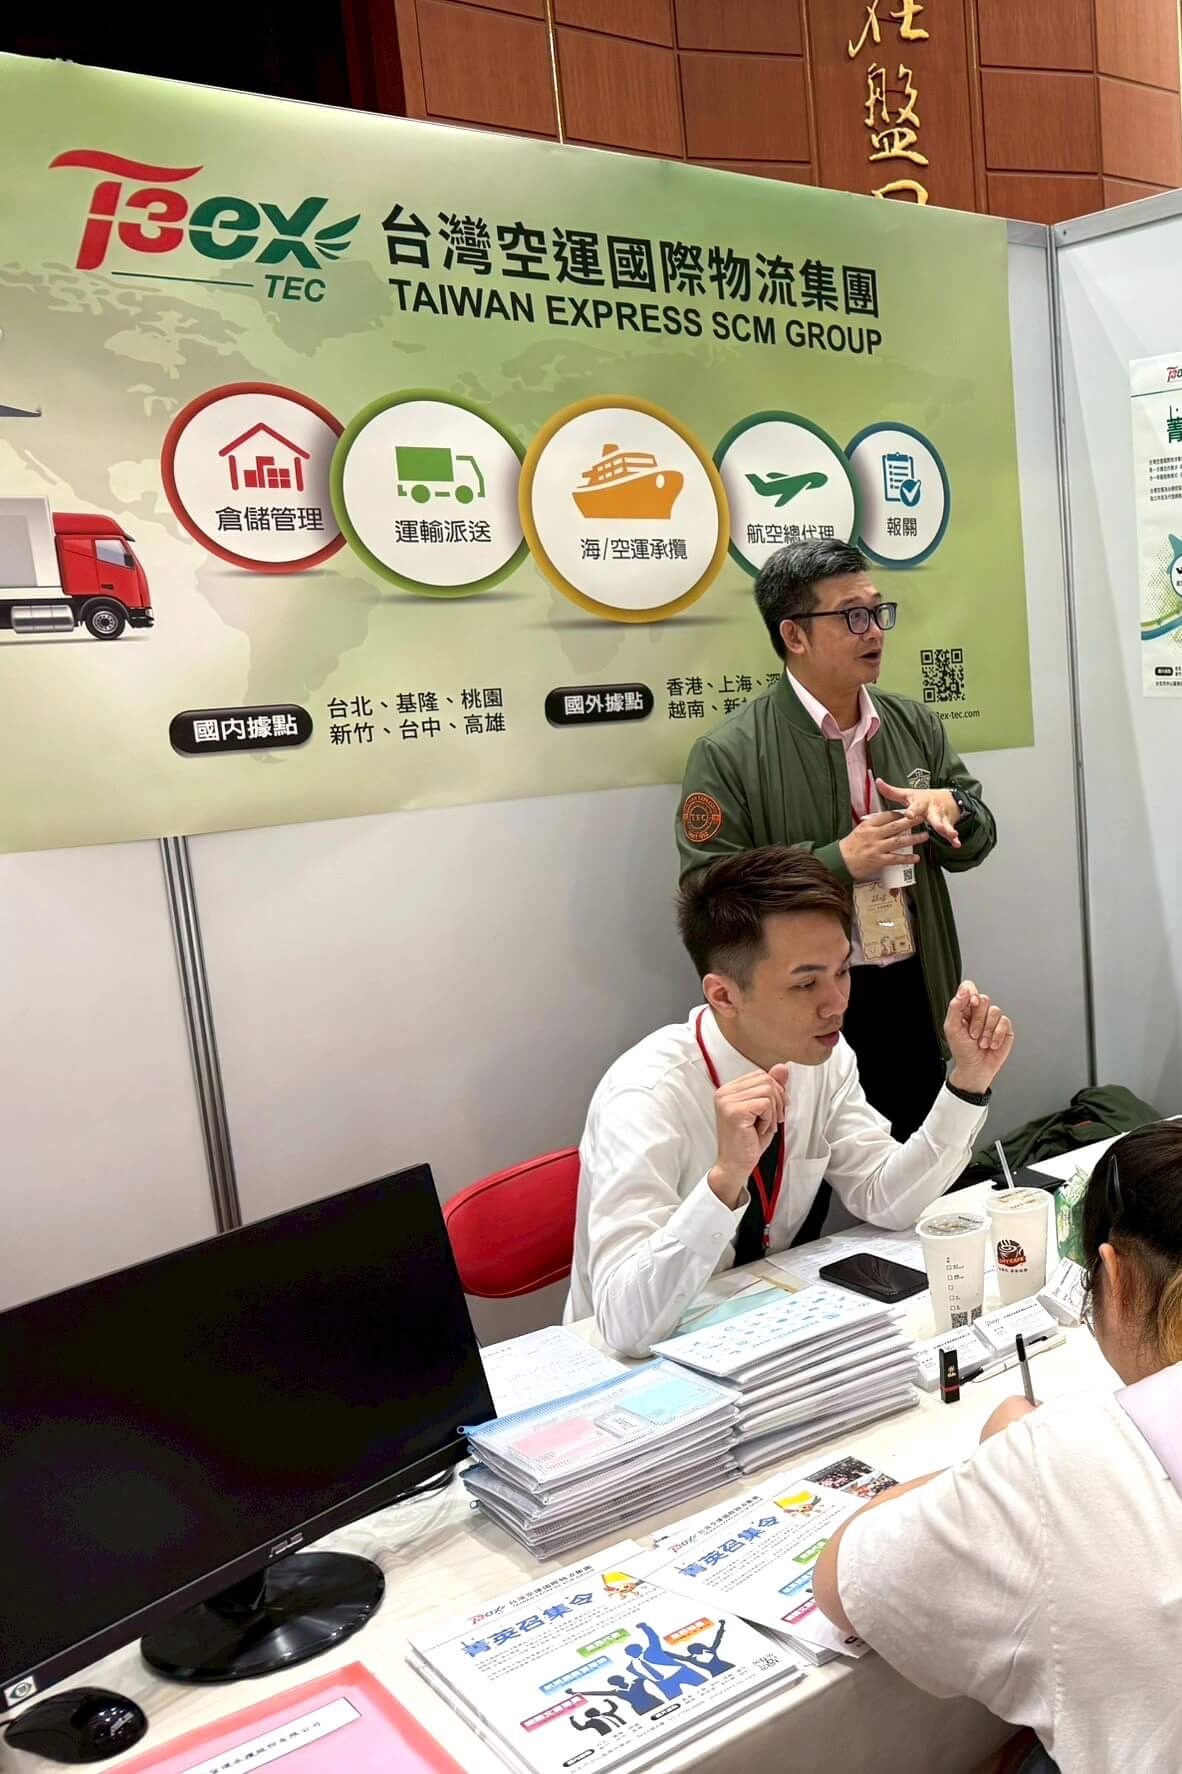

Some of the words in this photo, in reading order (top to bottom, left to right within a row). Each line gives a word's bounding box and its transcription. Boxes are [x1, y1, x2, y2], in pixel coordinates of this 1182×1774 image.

[381, 203, 881, 319] 台灣空運國際物流集團
[264, 274, 327, 302] TEC
[388, 278, 536, 323] TAIWAN
[545, 295, 703, 337] EXPRESS
[712, 311, 777, 345] SCM
[785, 319, 883, 355] GROUP
[215, 505, 325, 533] 倉儲管理
[394, 519, 492, 545] 運輸派送
[886, 516, 918, 537] 報關
[580, 537, 688, 562] 海/空運承攬
[326, 687, 504, 721] 台北、基隆、桃園
[563, 690, 644, 717] 國外據點
[667, 696, 748, 720] 越南、新
[192, 714, 299, 744] 國內據點
[329, 711, 507, 746] 新竹、台中、高雄
